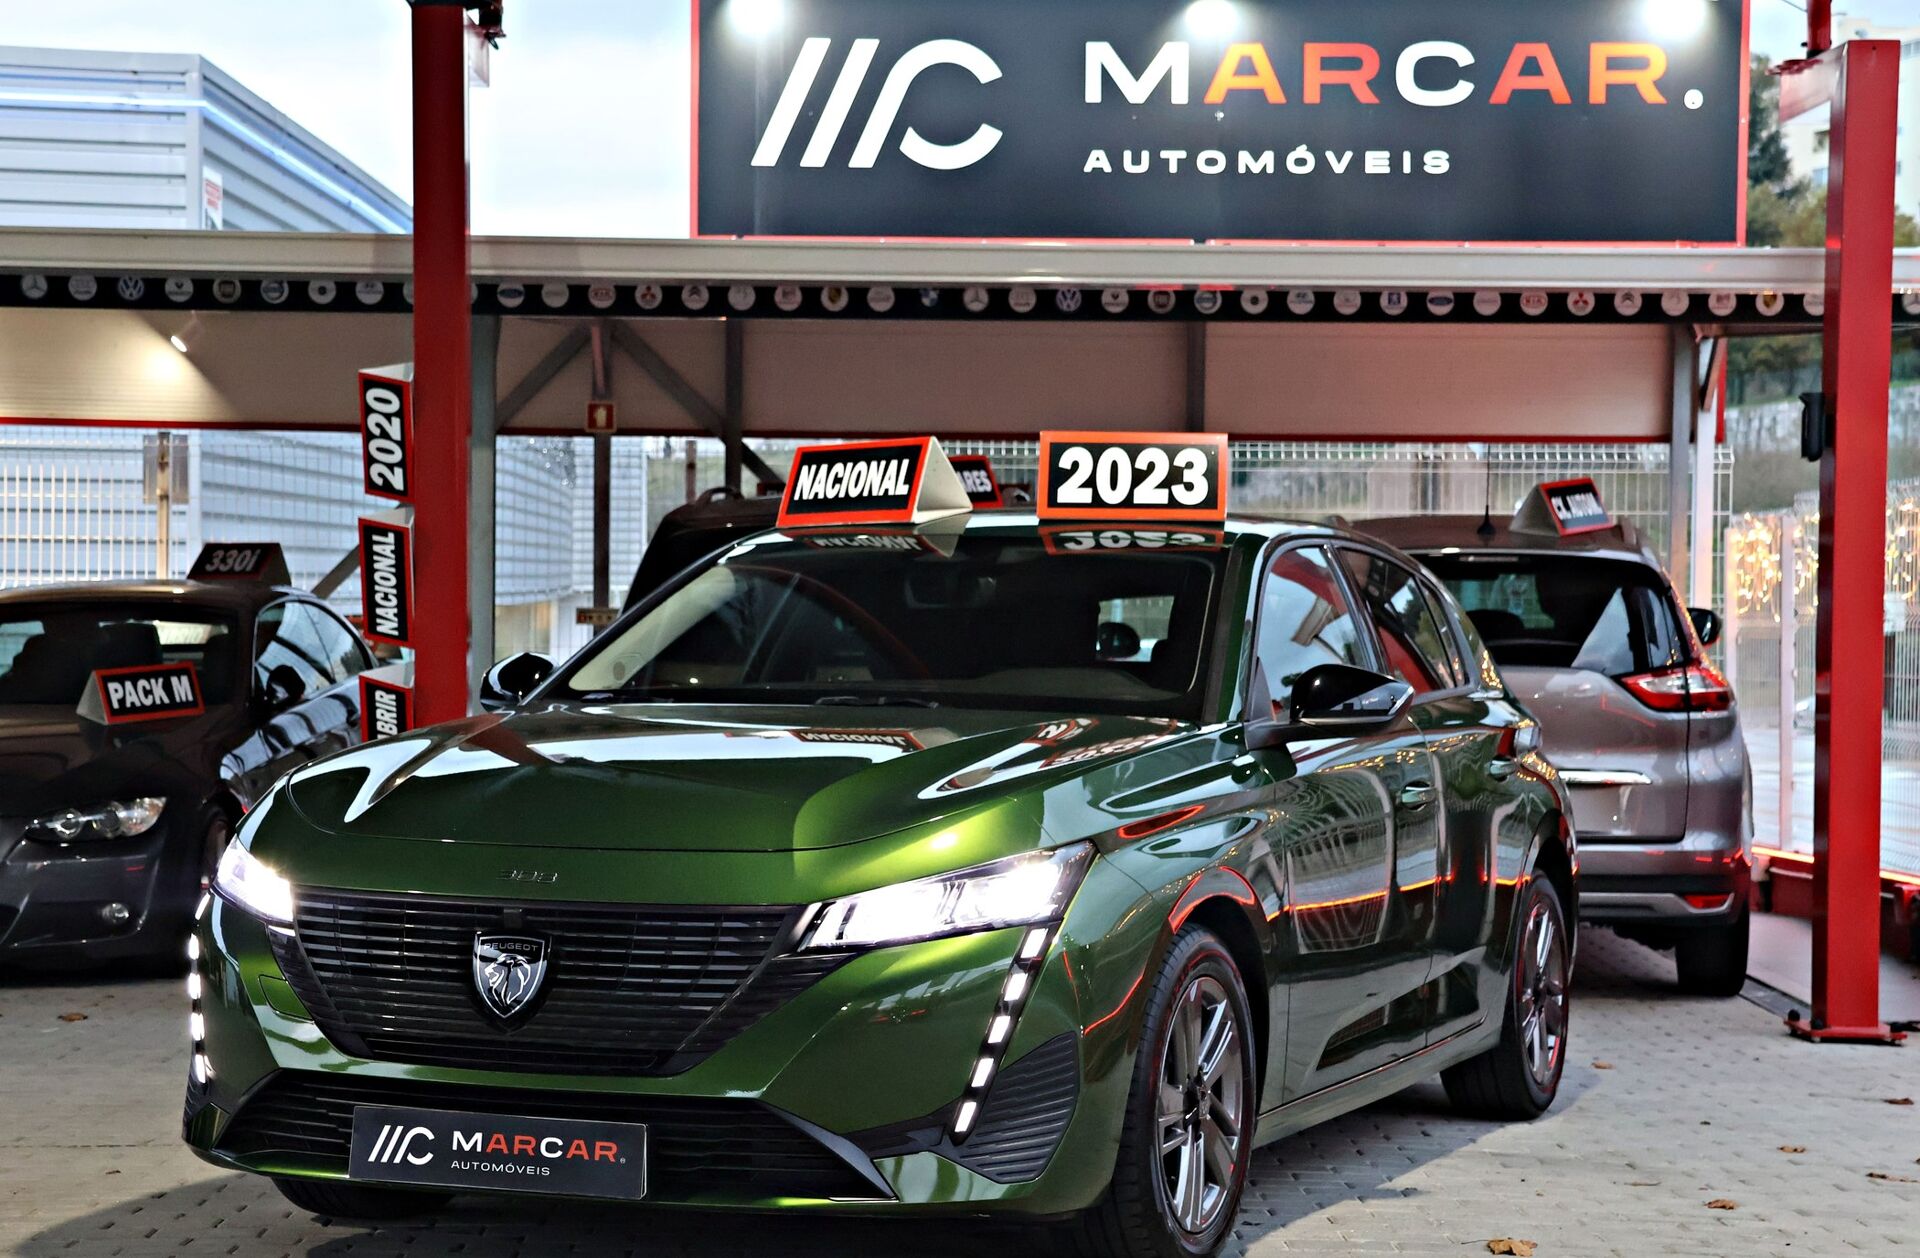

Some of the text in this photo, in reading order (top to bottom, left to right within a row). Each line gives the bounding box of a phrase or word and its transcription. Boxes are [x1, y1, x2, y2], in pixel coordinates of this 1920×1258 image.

[1083, 144, 1451, 175] AUTOMÓVEIS
[365, 387, 405, 491] 2020
[794, 458, 910, 501] NACIONAL
[1057, 446, 1209, 505] 2023
[372, 531, 399, 637] NACIONAL
[107, 674, 194, 710] PACK M
[374, 689, 398, 740] BRIR
[484, 942, 539, 952] PEUGEOT
[451, 1160, 550, 1176] AUTOMÓVEIS
